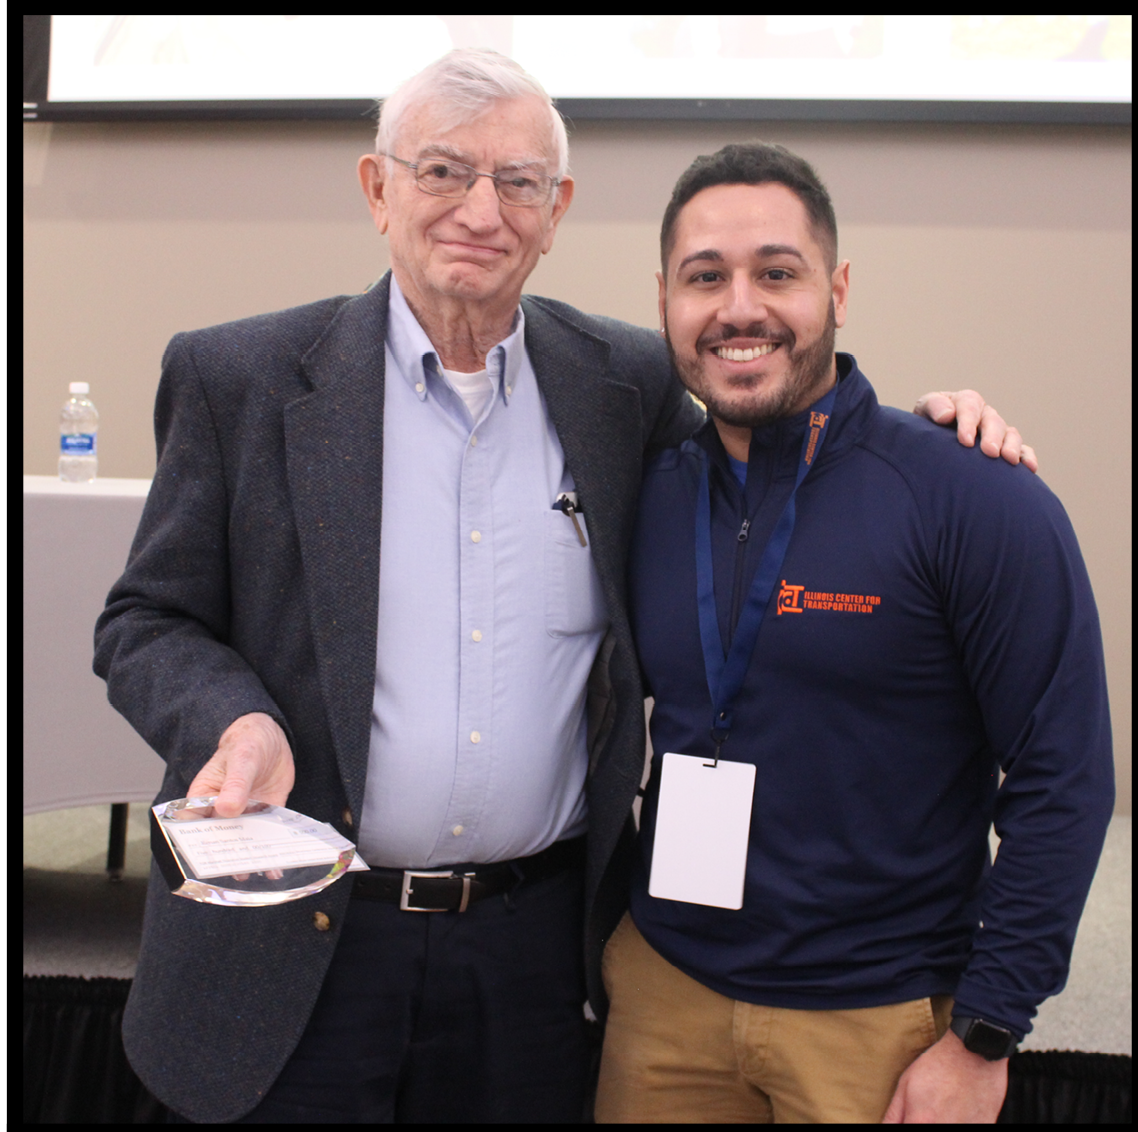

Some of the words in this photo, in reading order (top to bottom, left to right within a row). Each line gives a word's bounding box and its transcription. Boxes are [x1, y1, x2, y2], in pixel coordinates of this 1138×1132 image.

[804, 591, 834, 602] ILLINOIS
[835, 593, 864, 605] CENTER
[865, 595, 881, 605] FOR
[803, 600, 873, 613] TRANSPORTATION
[179, 826, 203, 835] Bank
[214, 824, 244, 832] Money
